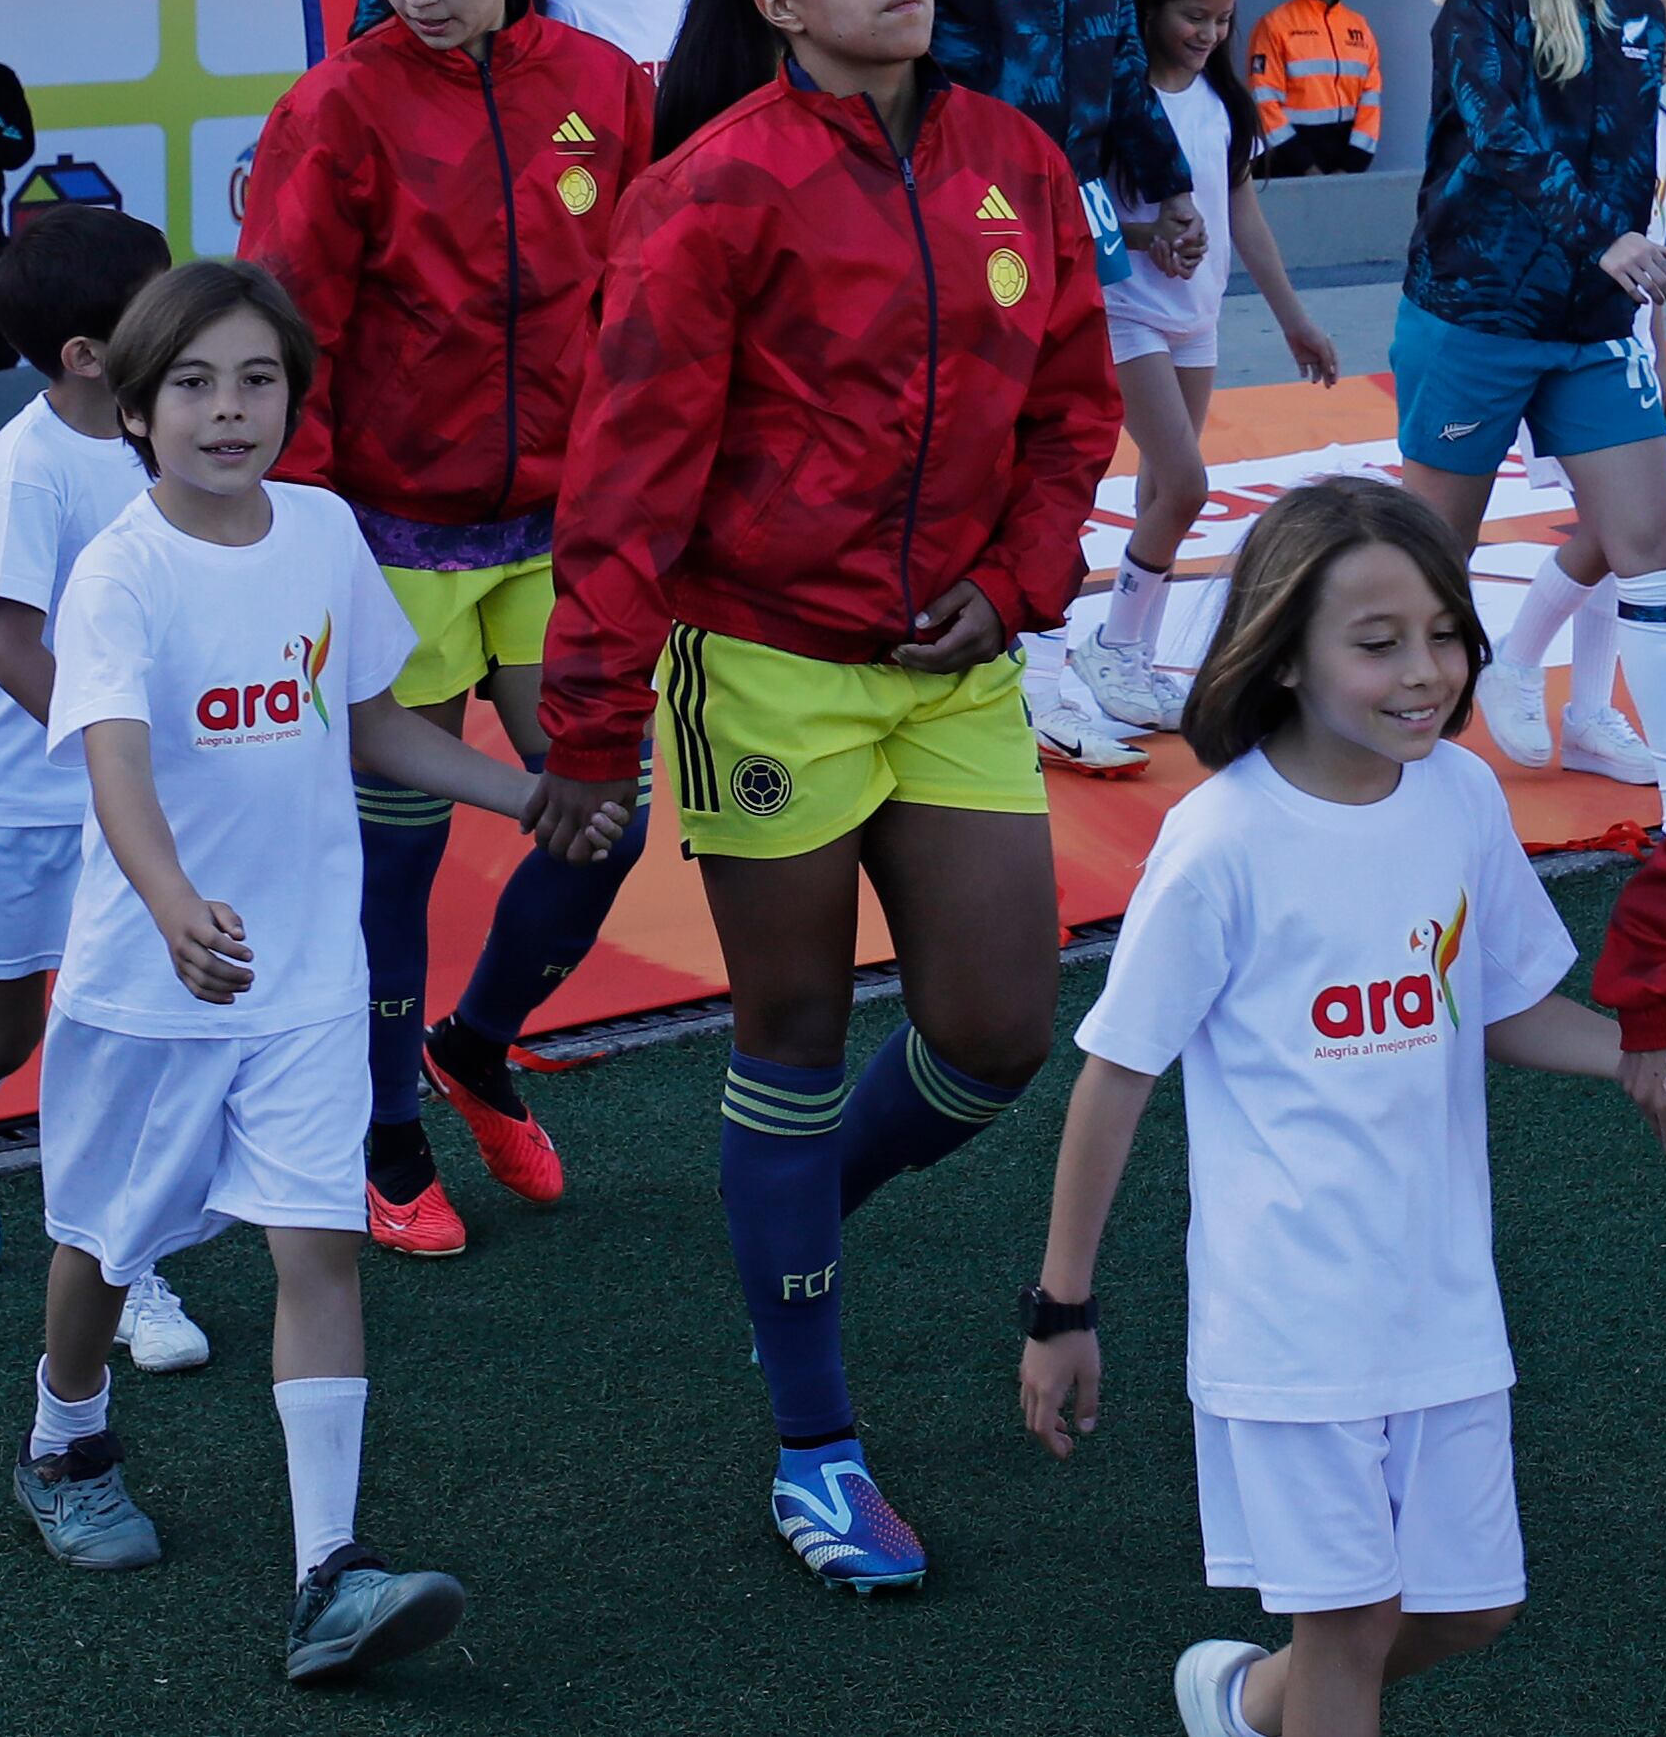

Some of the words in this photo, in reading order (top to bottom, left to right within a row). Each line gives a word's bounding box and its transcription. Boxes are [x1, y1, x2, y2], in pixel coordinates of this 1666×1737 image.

[195, 678, 300, 732] ara
[1311, 973, 1434, 1040] ara
[1362, 1042, 1373, 1056] al
[1376, 1038, 1408, 1057] mejor
[1408, 1031, 1438, 1050] precio
[782, 1260, 839, 1302] FCF
